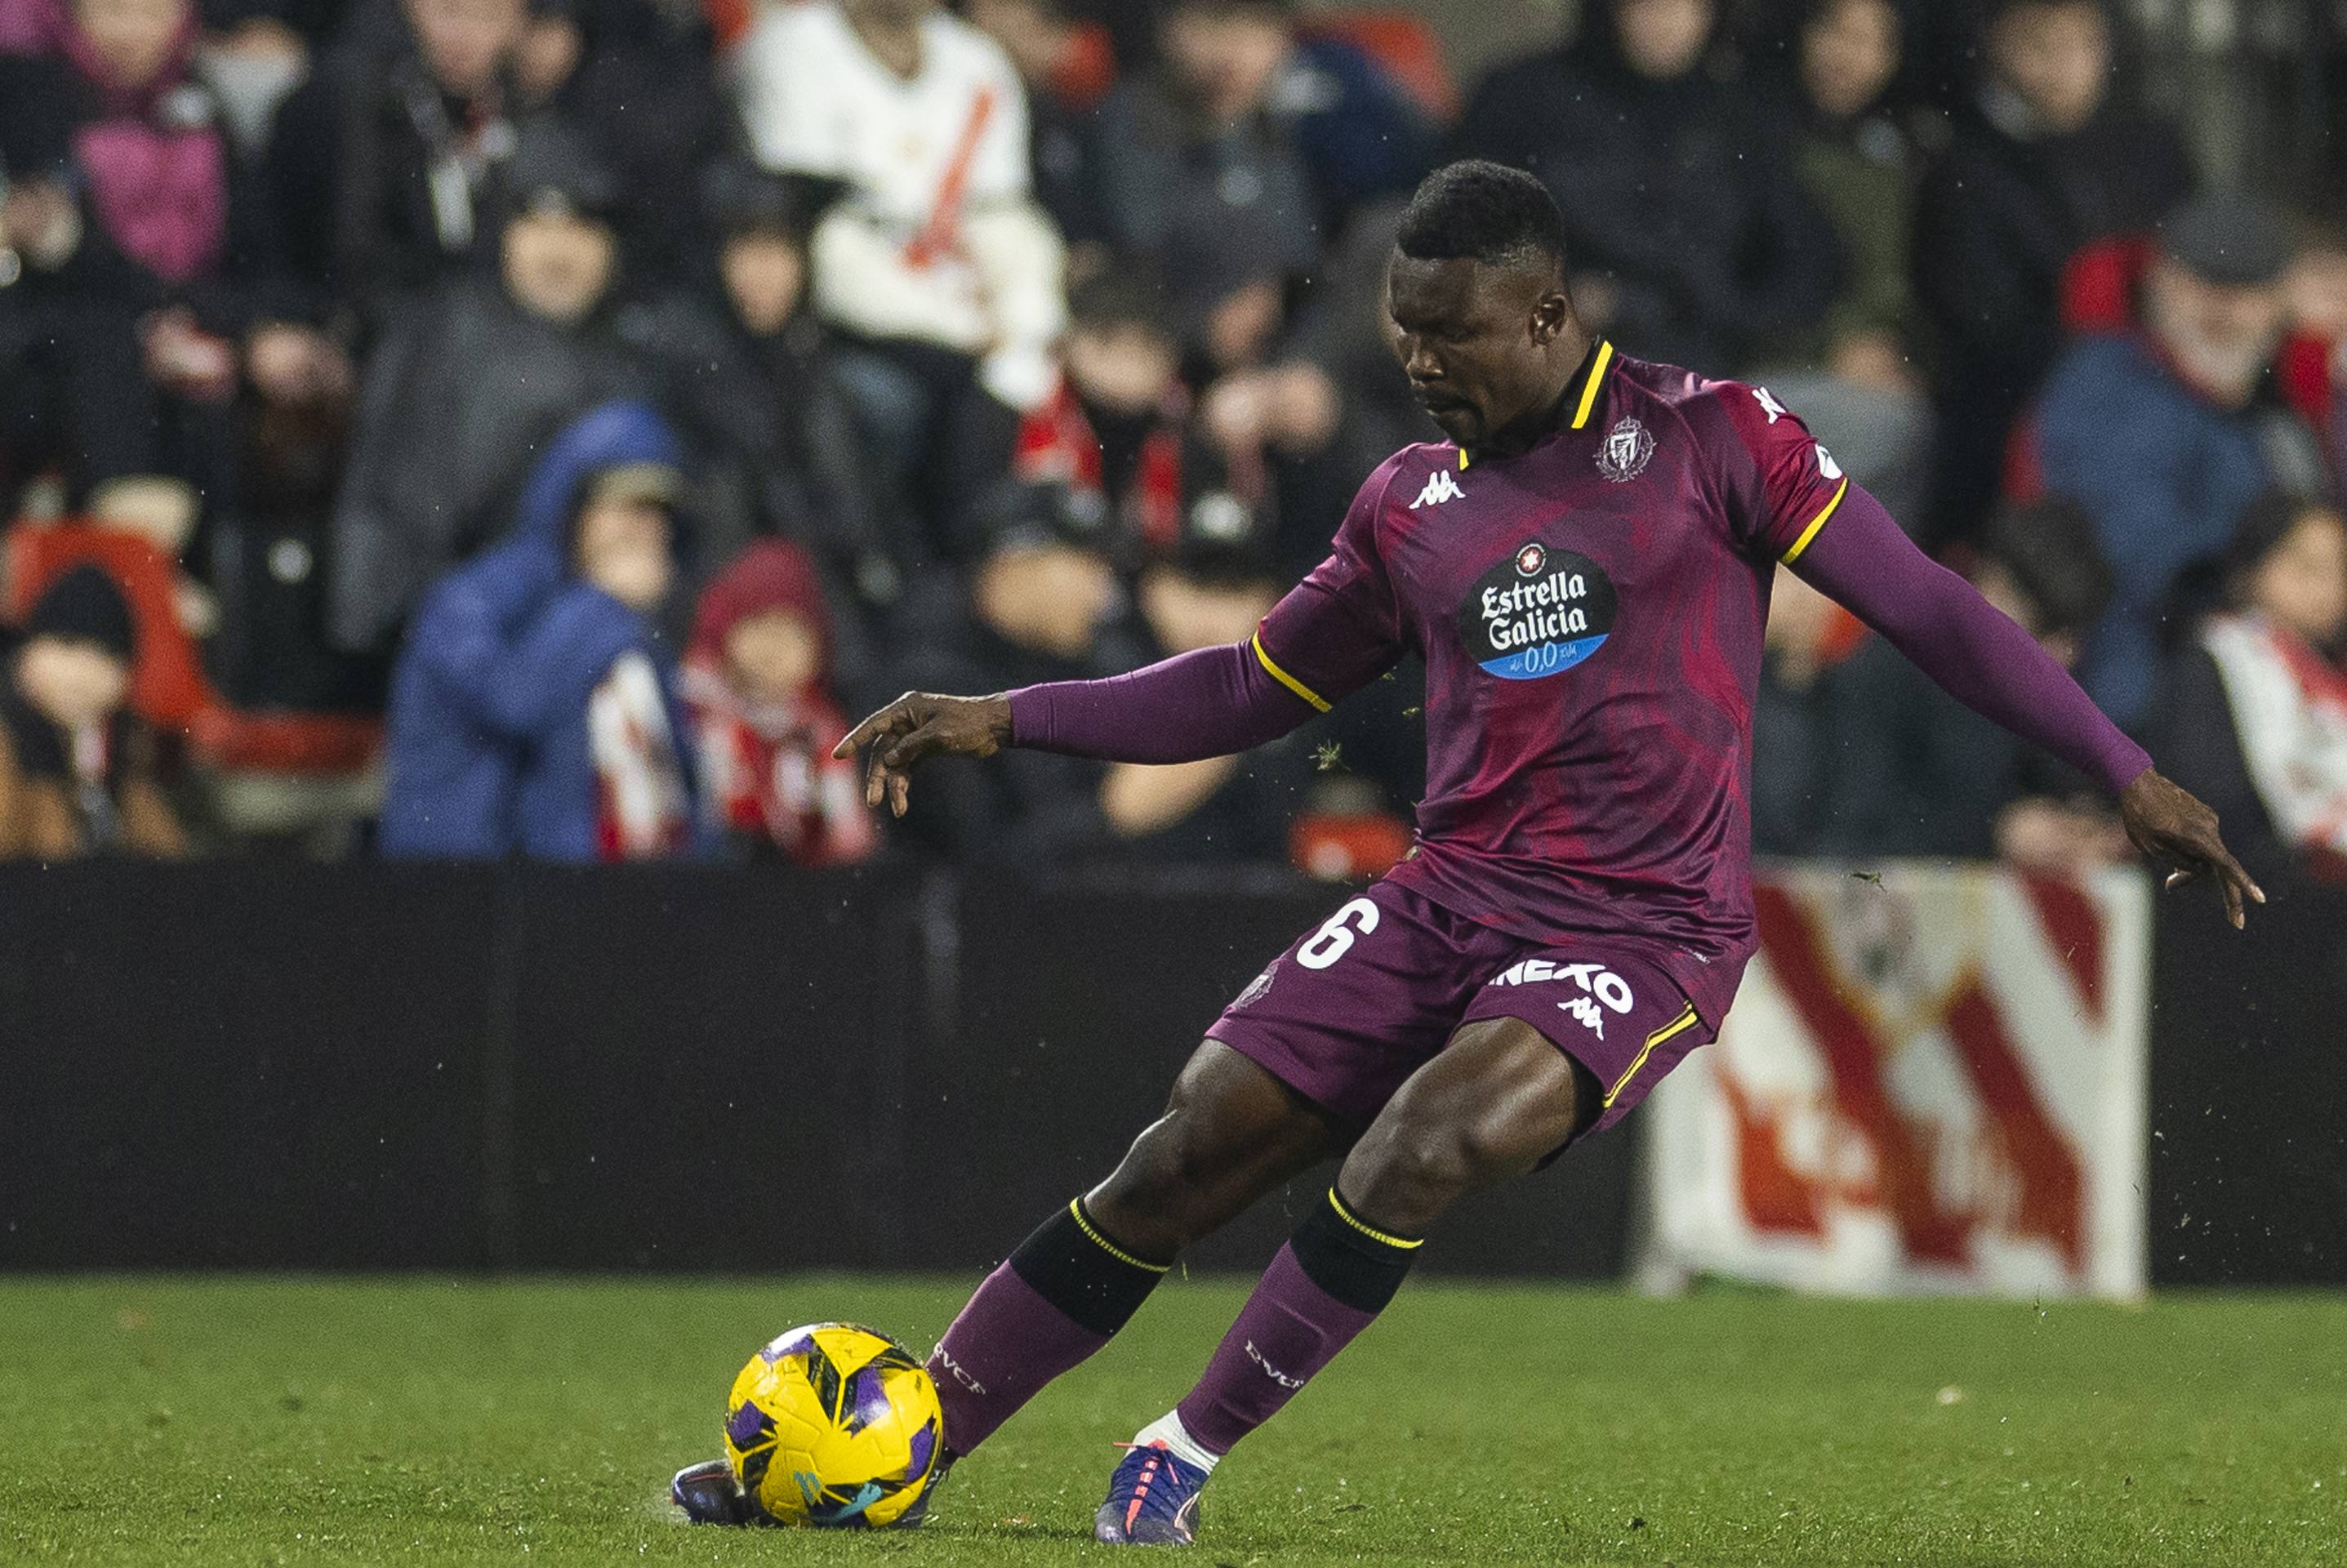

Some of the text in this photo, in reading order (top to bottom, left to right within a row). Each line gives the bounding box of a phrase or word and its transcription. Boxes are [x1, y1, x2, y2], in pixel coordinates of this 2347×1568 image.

[1481, 571, 1587, 621] Estrella
[1489, 604, 1588, 651] Galicia
[1525, 641, 1557, 673] 0,0
[1296, 898, 1380, 969] 6
